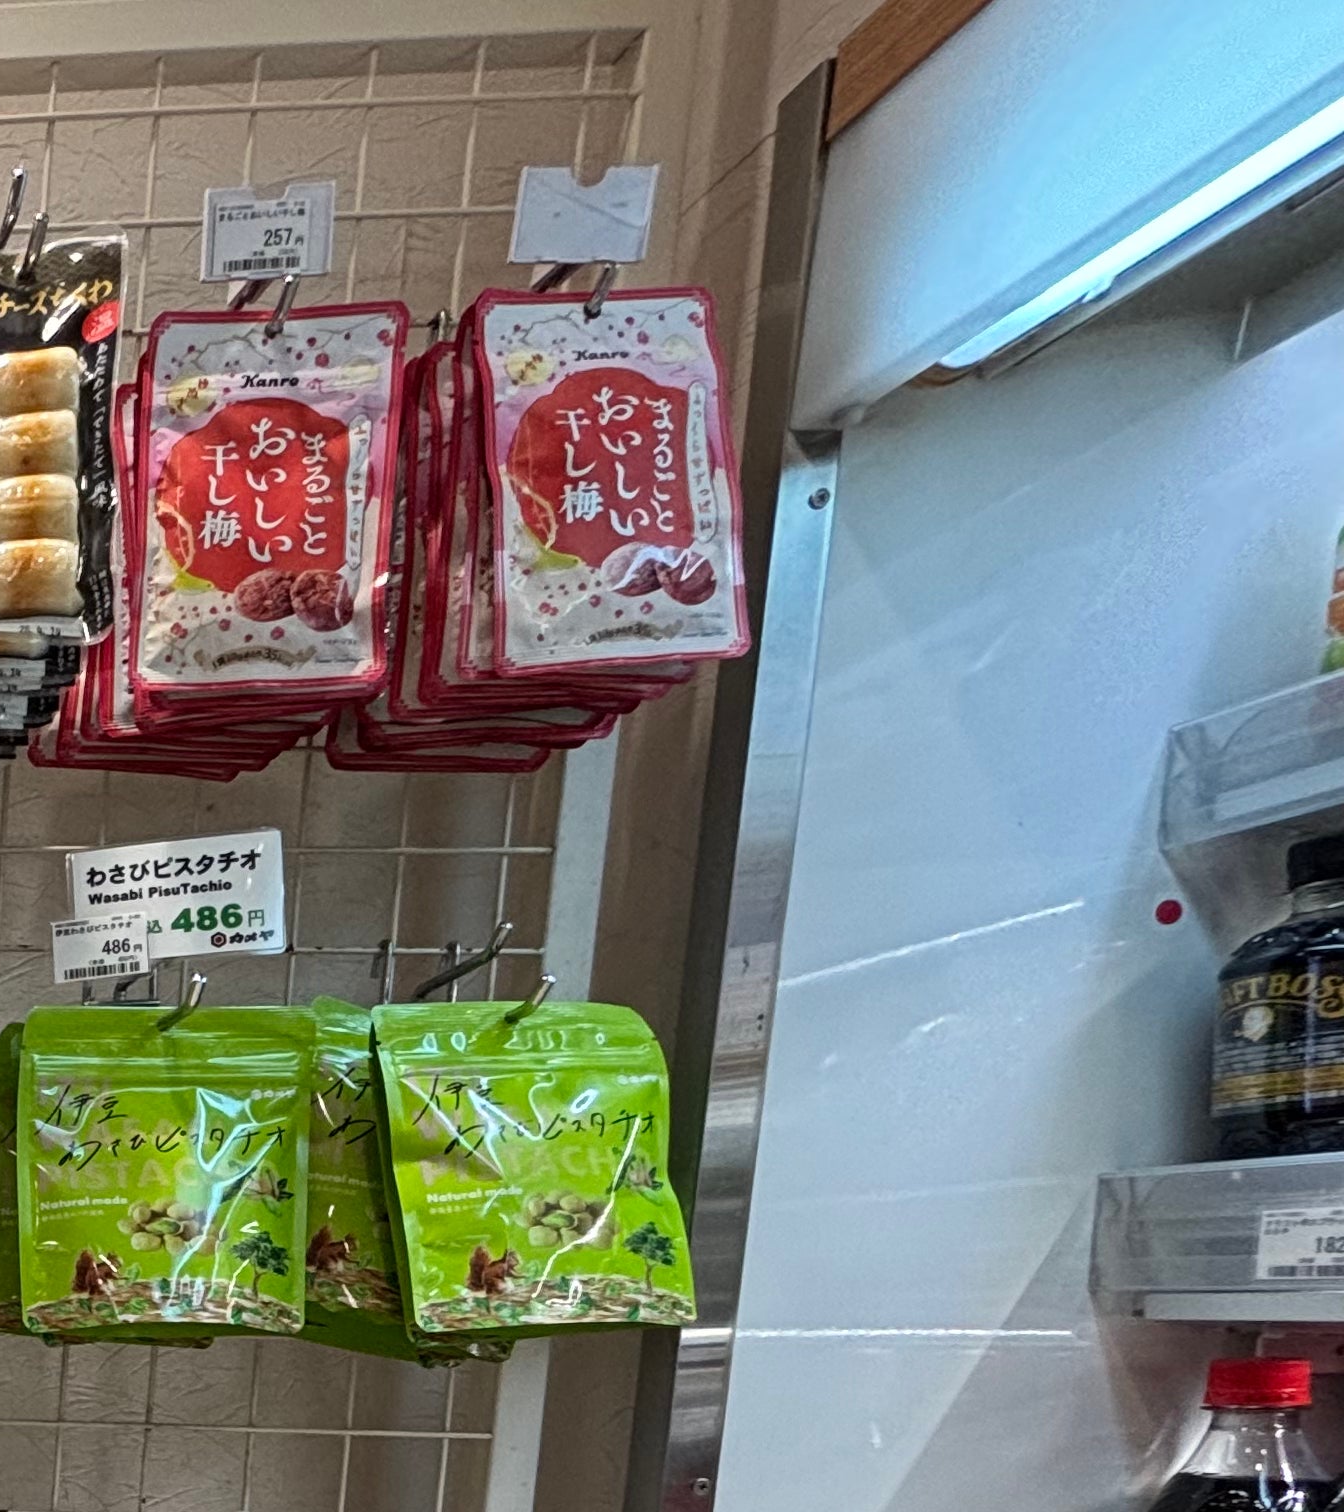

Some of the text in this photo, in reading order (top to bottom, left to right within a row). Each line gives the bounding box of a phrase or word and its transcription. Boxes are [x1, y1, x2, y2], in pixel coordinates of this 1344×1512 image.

[572, 349, 630, 363] Kanro
[240, 373, 300, 389] Kanro
[555, 408, 605, 525] 干し梅
[592, 384, 650, 537] おいしい
[644, 397, 679, 534] まるごと
[198, 442, 242, 551] 干し梅
[246, 416, 295, 564] おいしい
[302, 431, 334, 556] まるごと
[86, 850, 261, 887] わさびピスタチオ
[89, 880, 233, 905] Wasabi PisuTachio
[1223, 976, 1261, 1003] AFT
[40, 1195, 128, 1211] Natural made
[426, 1184, 524, 1205] Natural made
